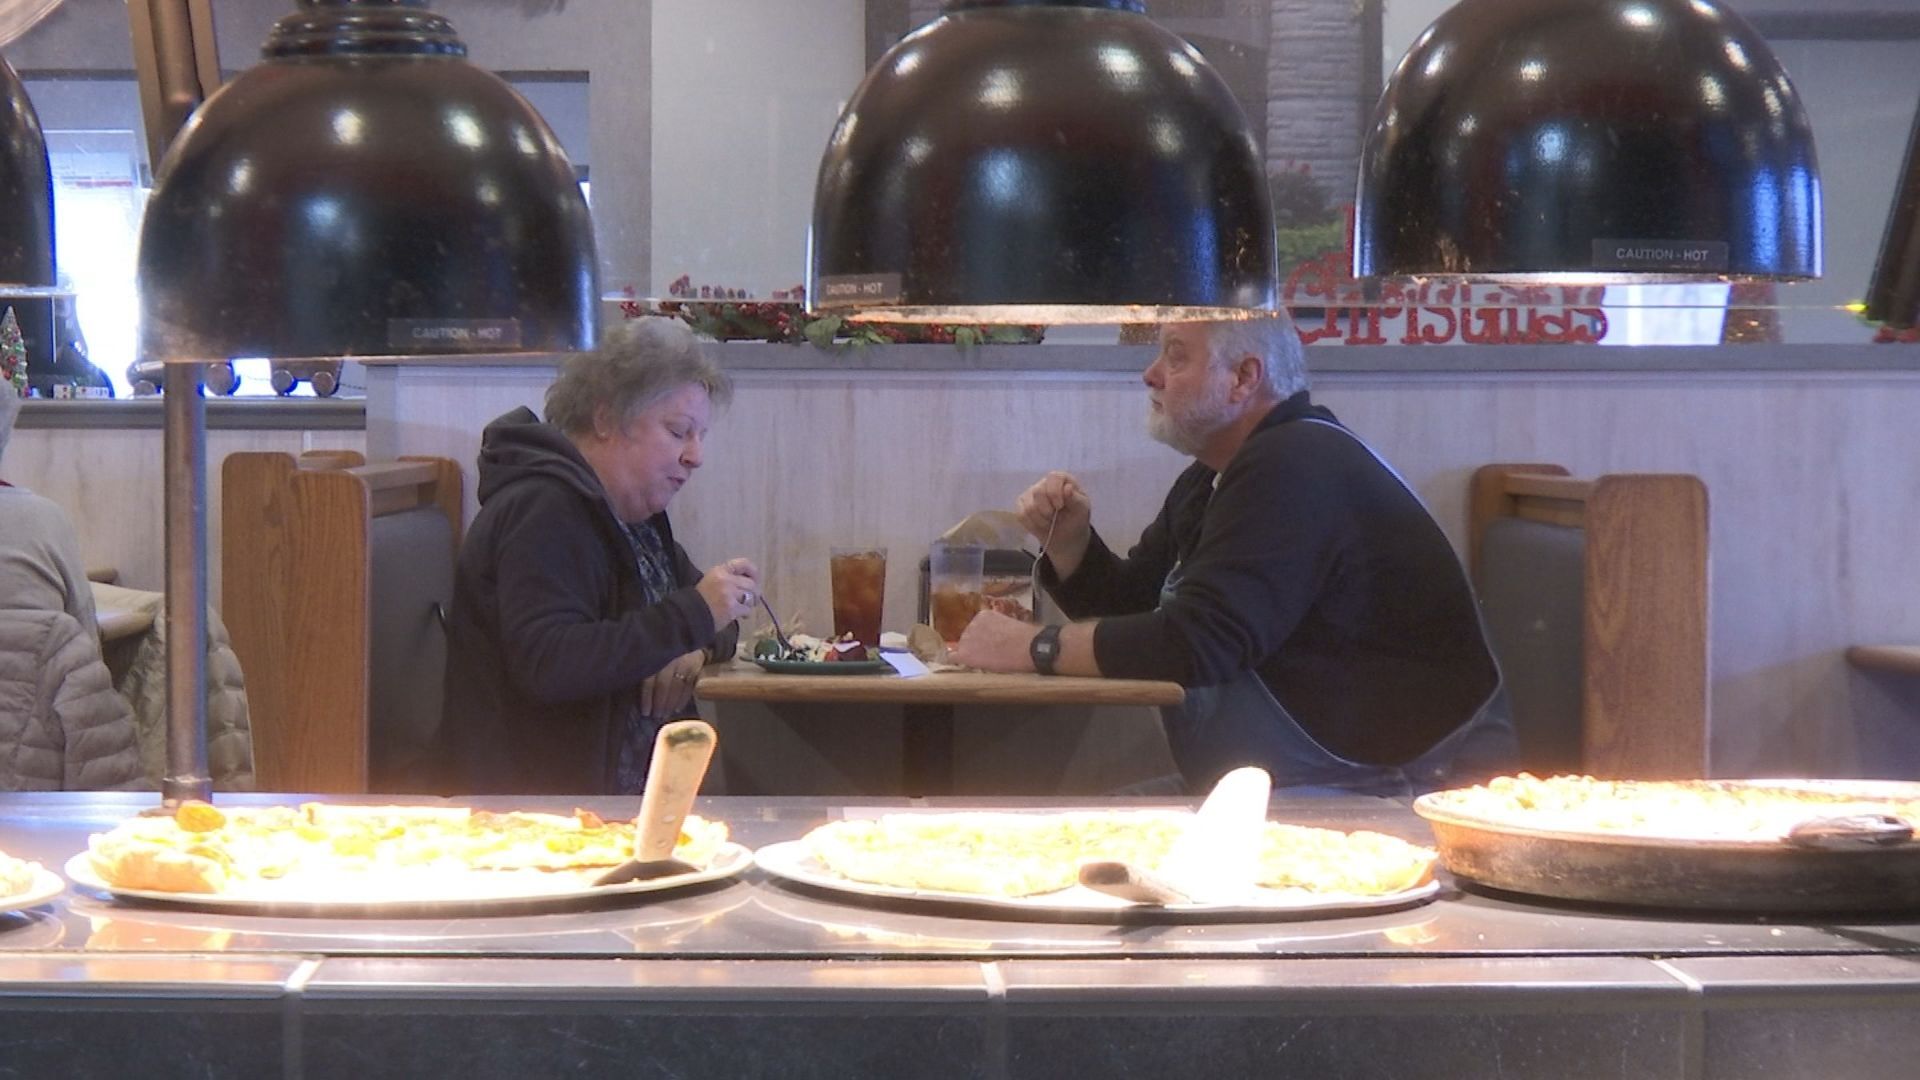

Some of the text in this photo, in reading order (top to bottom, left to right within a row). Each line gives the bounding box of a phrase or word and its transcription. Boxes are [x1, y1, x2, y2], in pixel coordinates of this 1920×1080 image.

[1616, 247, 1673, 260] CAUTION
[1683, 249, 1709, 261] HOT
[863, 282, 883, 294] HOT
[411, 327, 469, 339] CAUTION
